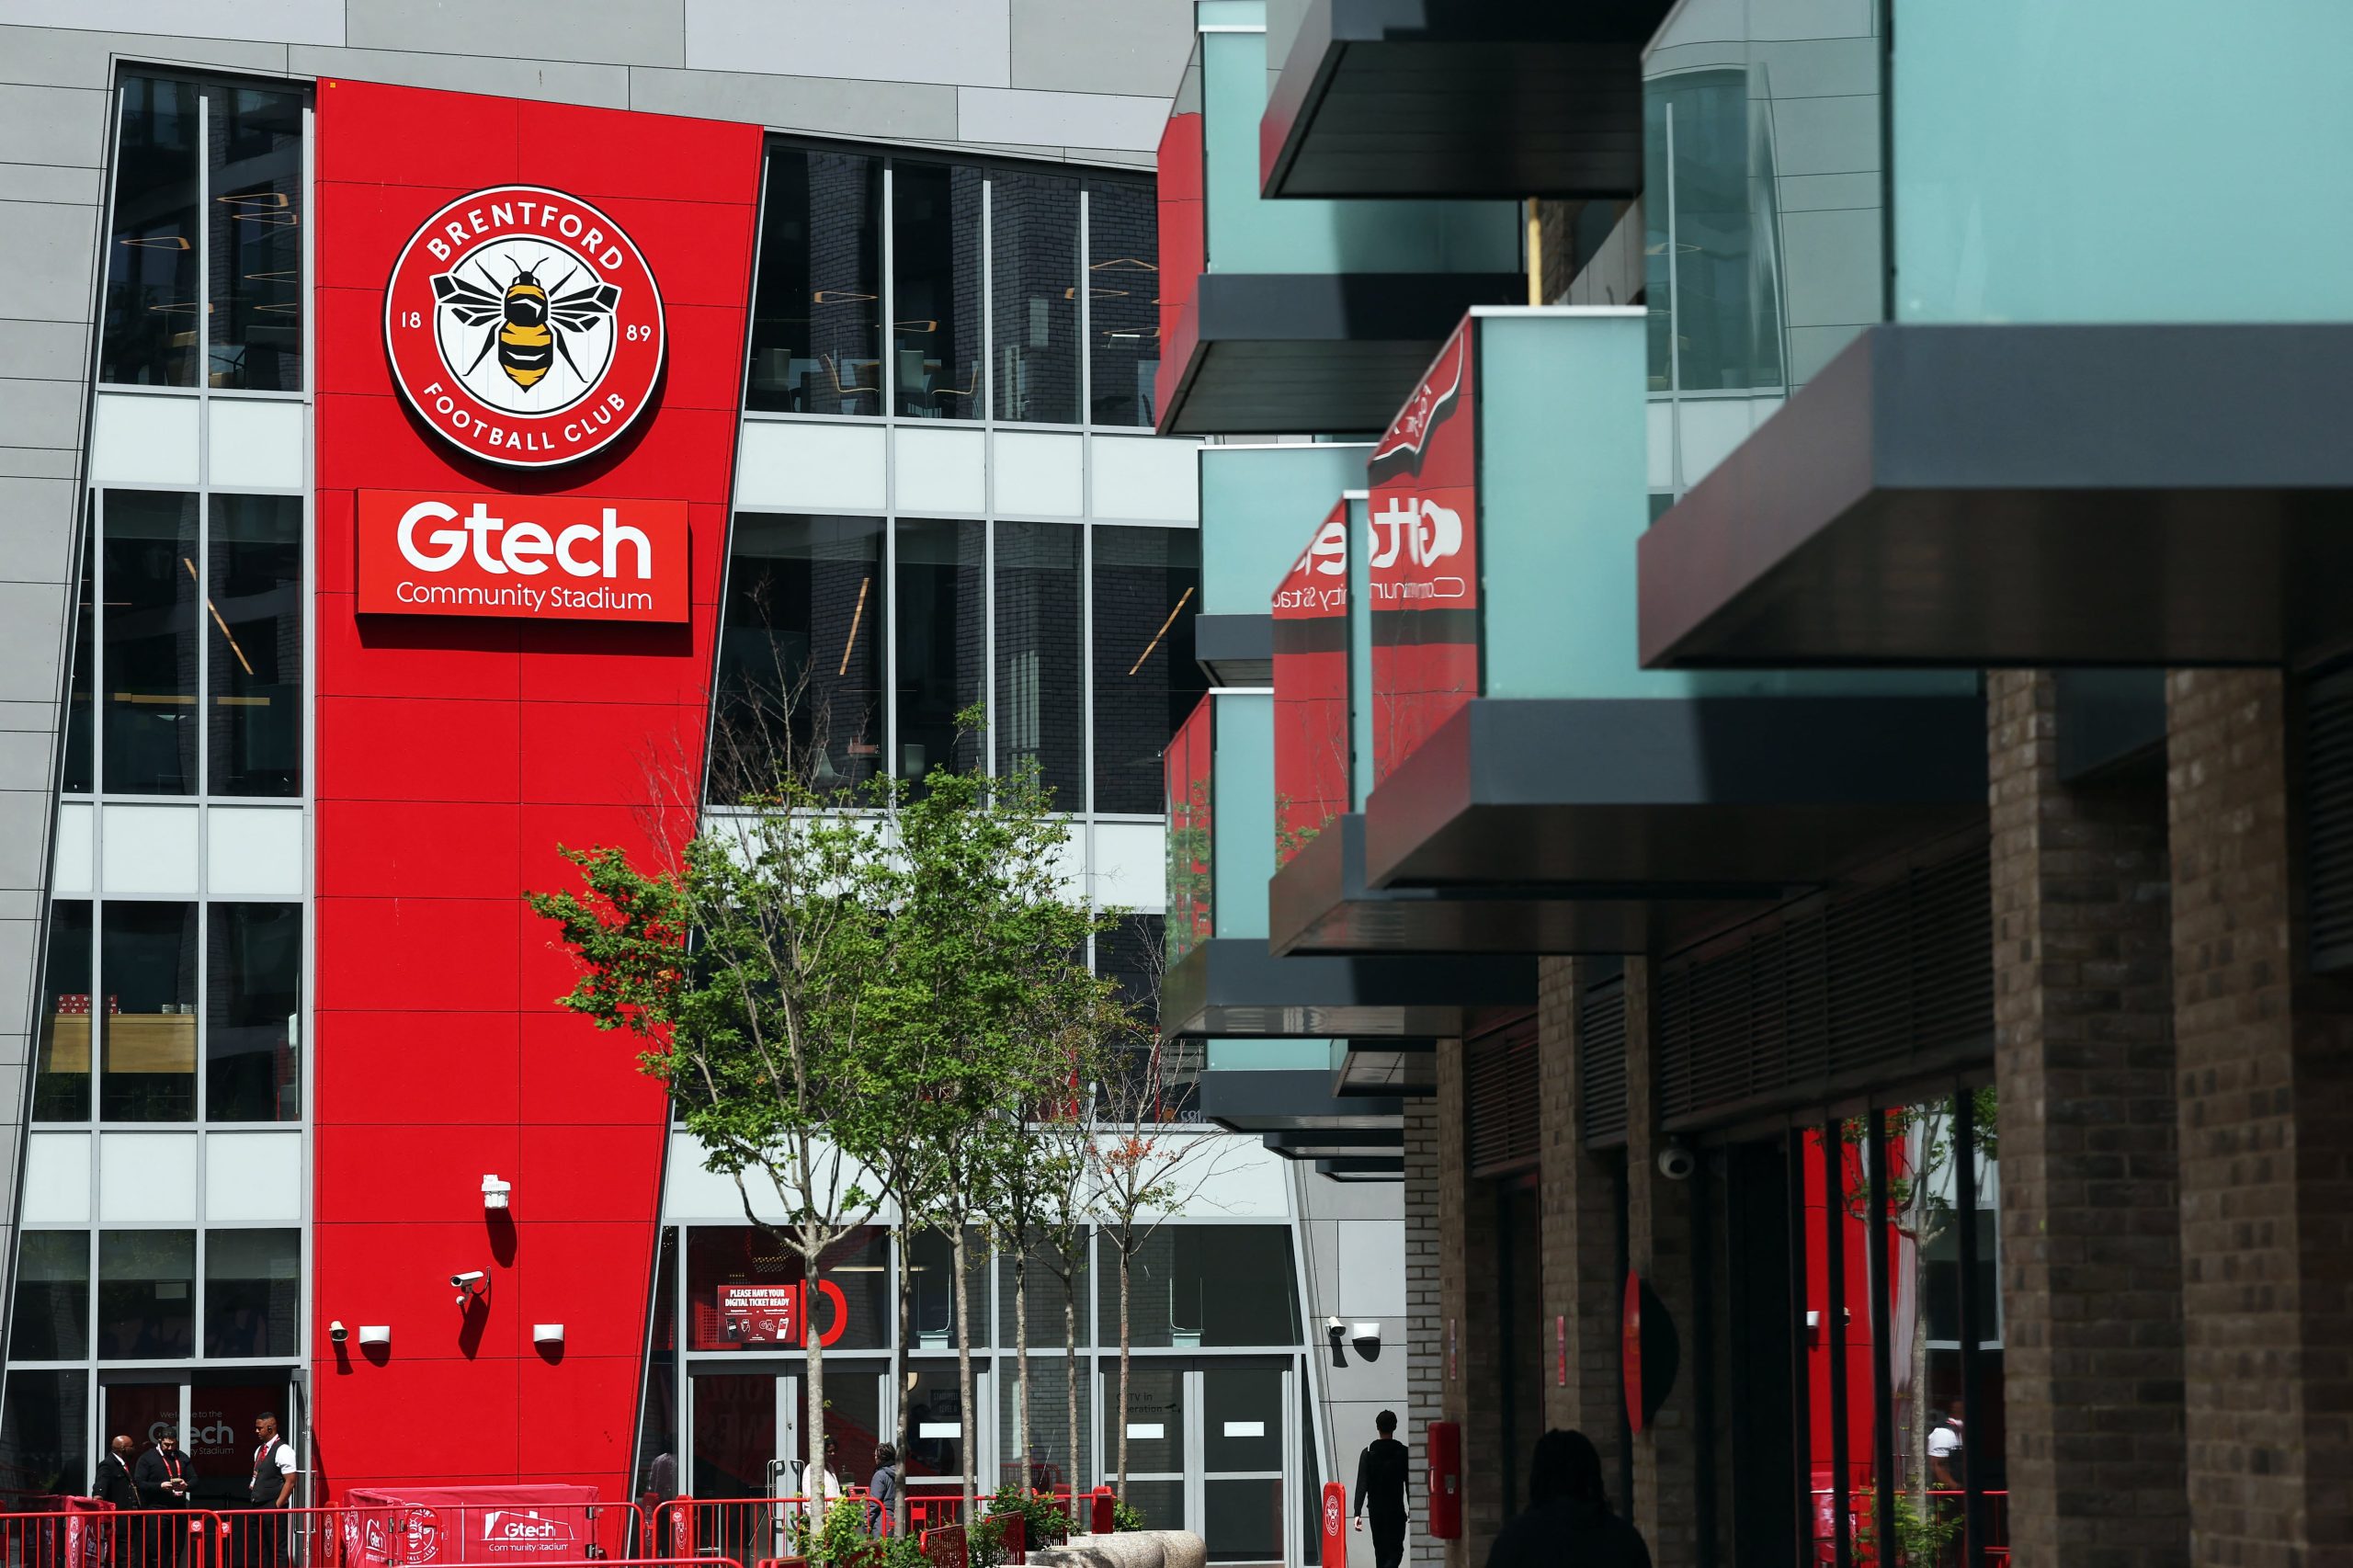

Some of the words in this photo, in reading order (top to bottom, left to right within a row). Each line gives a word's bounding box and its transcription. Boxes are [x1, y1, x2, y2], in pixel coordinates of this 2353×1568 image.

[427, 201, 623, 270] BRENTFORD
[402, 312, 422, 329] 18
[626, 324, 652, 342] 89
[424, 382, 555, 451] FOOTBALL
[563, 393, 625, 443] CLUB
[397, 501, 652, 579] Gtech
[396, 581, 547, 612] Community
[551, 586, 653, 610] Stadium
[730, 1289, 752, 1298] PLEASE
[752, 1289, 767, 1298] HAVE
[768, 1289, 785, 1298] YOUR
[725, 1298, 749, 1307] DIGITAL
[749, 1298, 770, 1307] TICKET
[770, 1298, 790, 1307] READY
[801, 1279, 847, 1347] D
[1117, 1392, 1141, 1403] TV
[1144, 1392, 1154, 1402] in
[160, 1410, 199, 1418] Wele
[210, 1410, 222, 1418] the
[1117, 1403, 1163, 1414] eration
[199, 1446, 234, 1455] Stadium
[505, 1521, 556, 1538] Gtech
